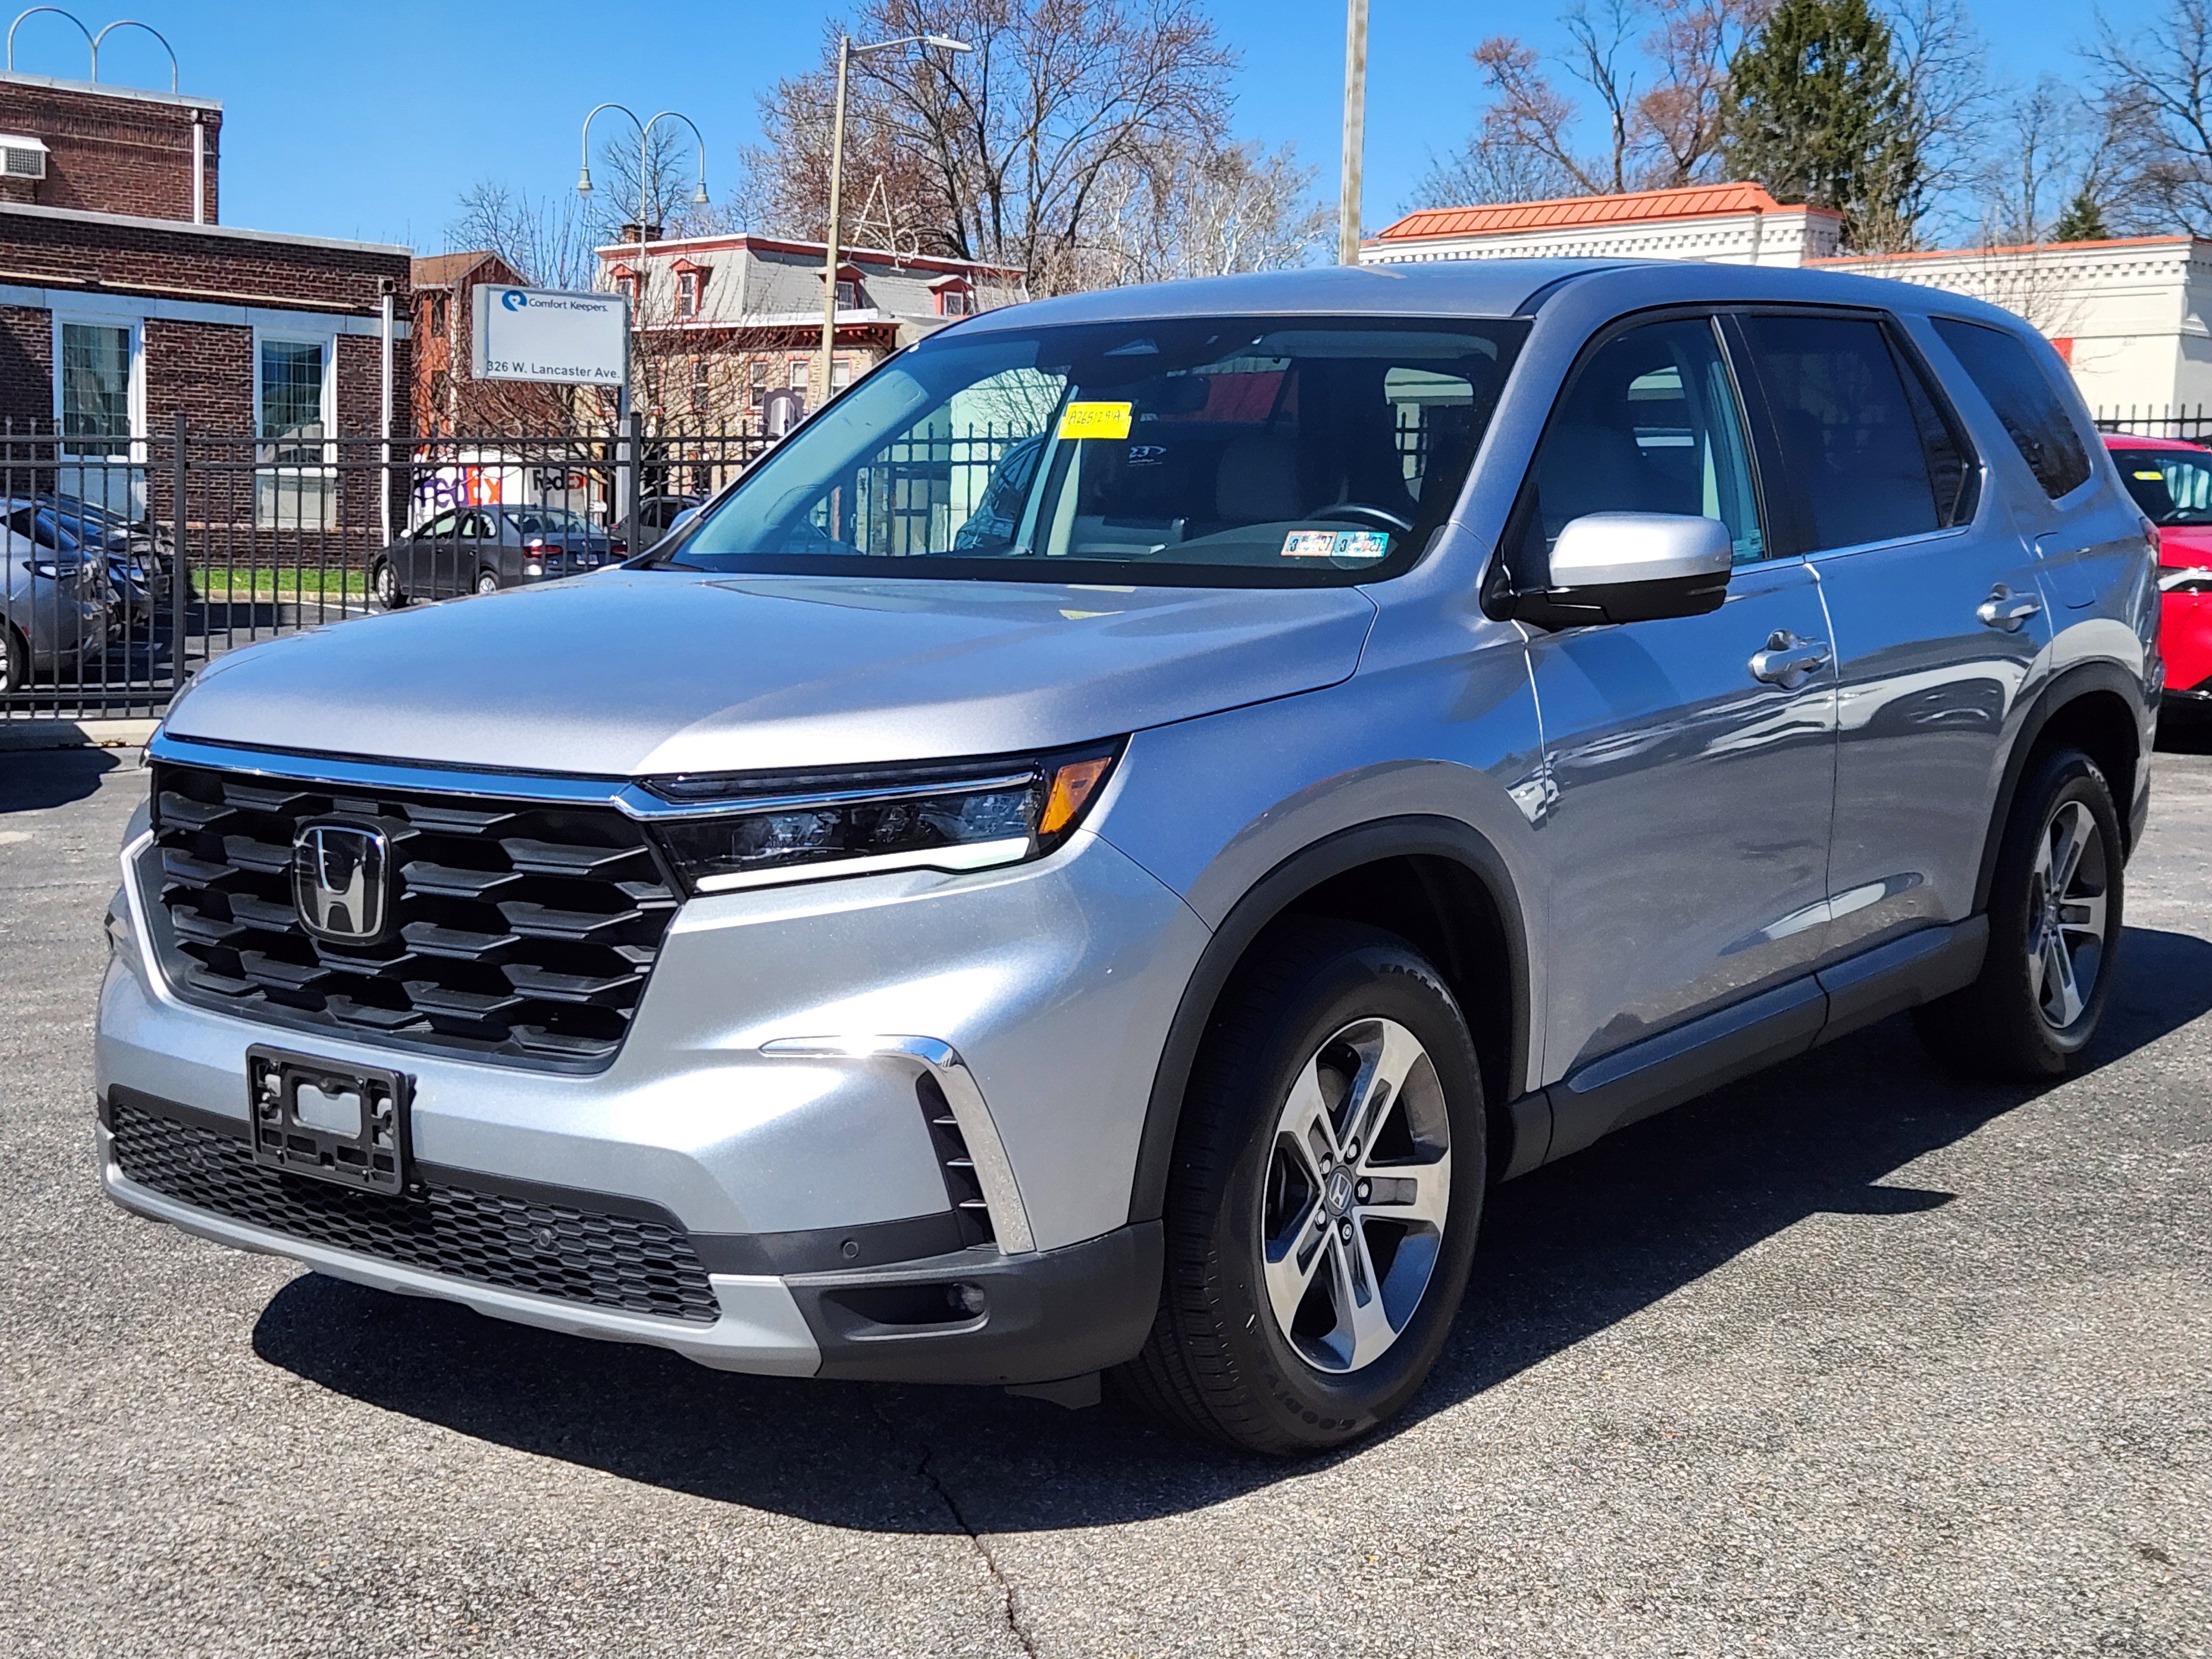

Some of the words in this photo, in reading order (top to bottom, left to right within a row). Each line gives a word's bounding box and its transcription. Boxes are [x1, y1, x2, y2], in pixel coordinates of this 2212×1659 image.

[529, 298, 567, 309] Comfort
[570, 301, 608, 312] Keepers
[512, 362, 528, 374] W.
[531, 363, 592, 377] Lancaster
[594, 367, 620, 379] Ave.
